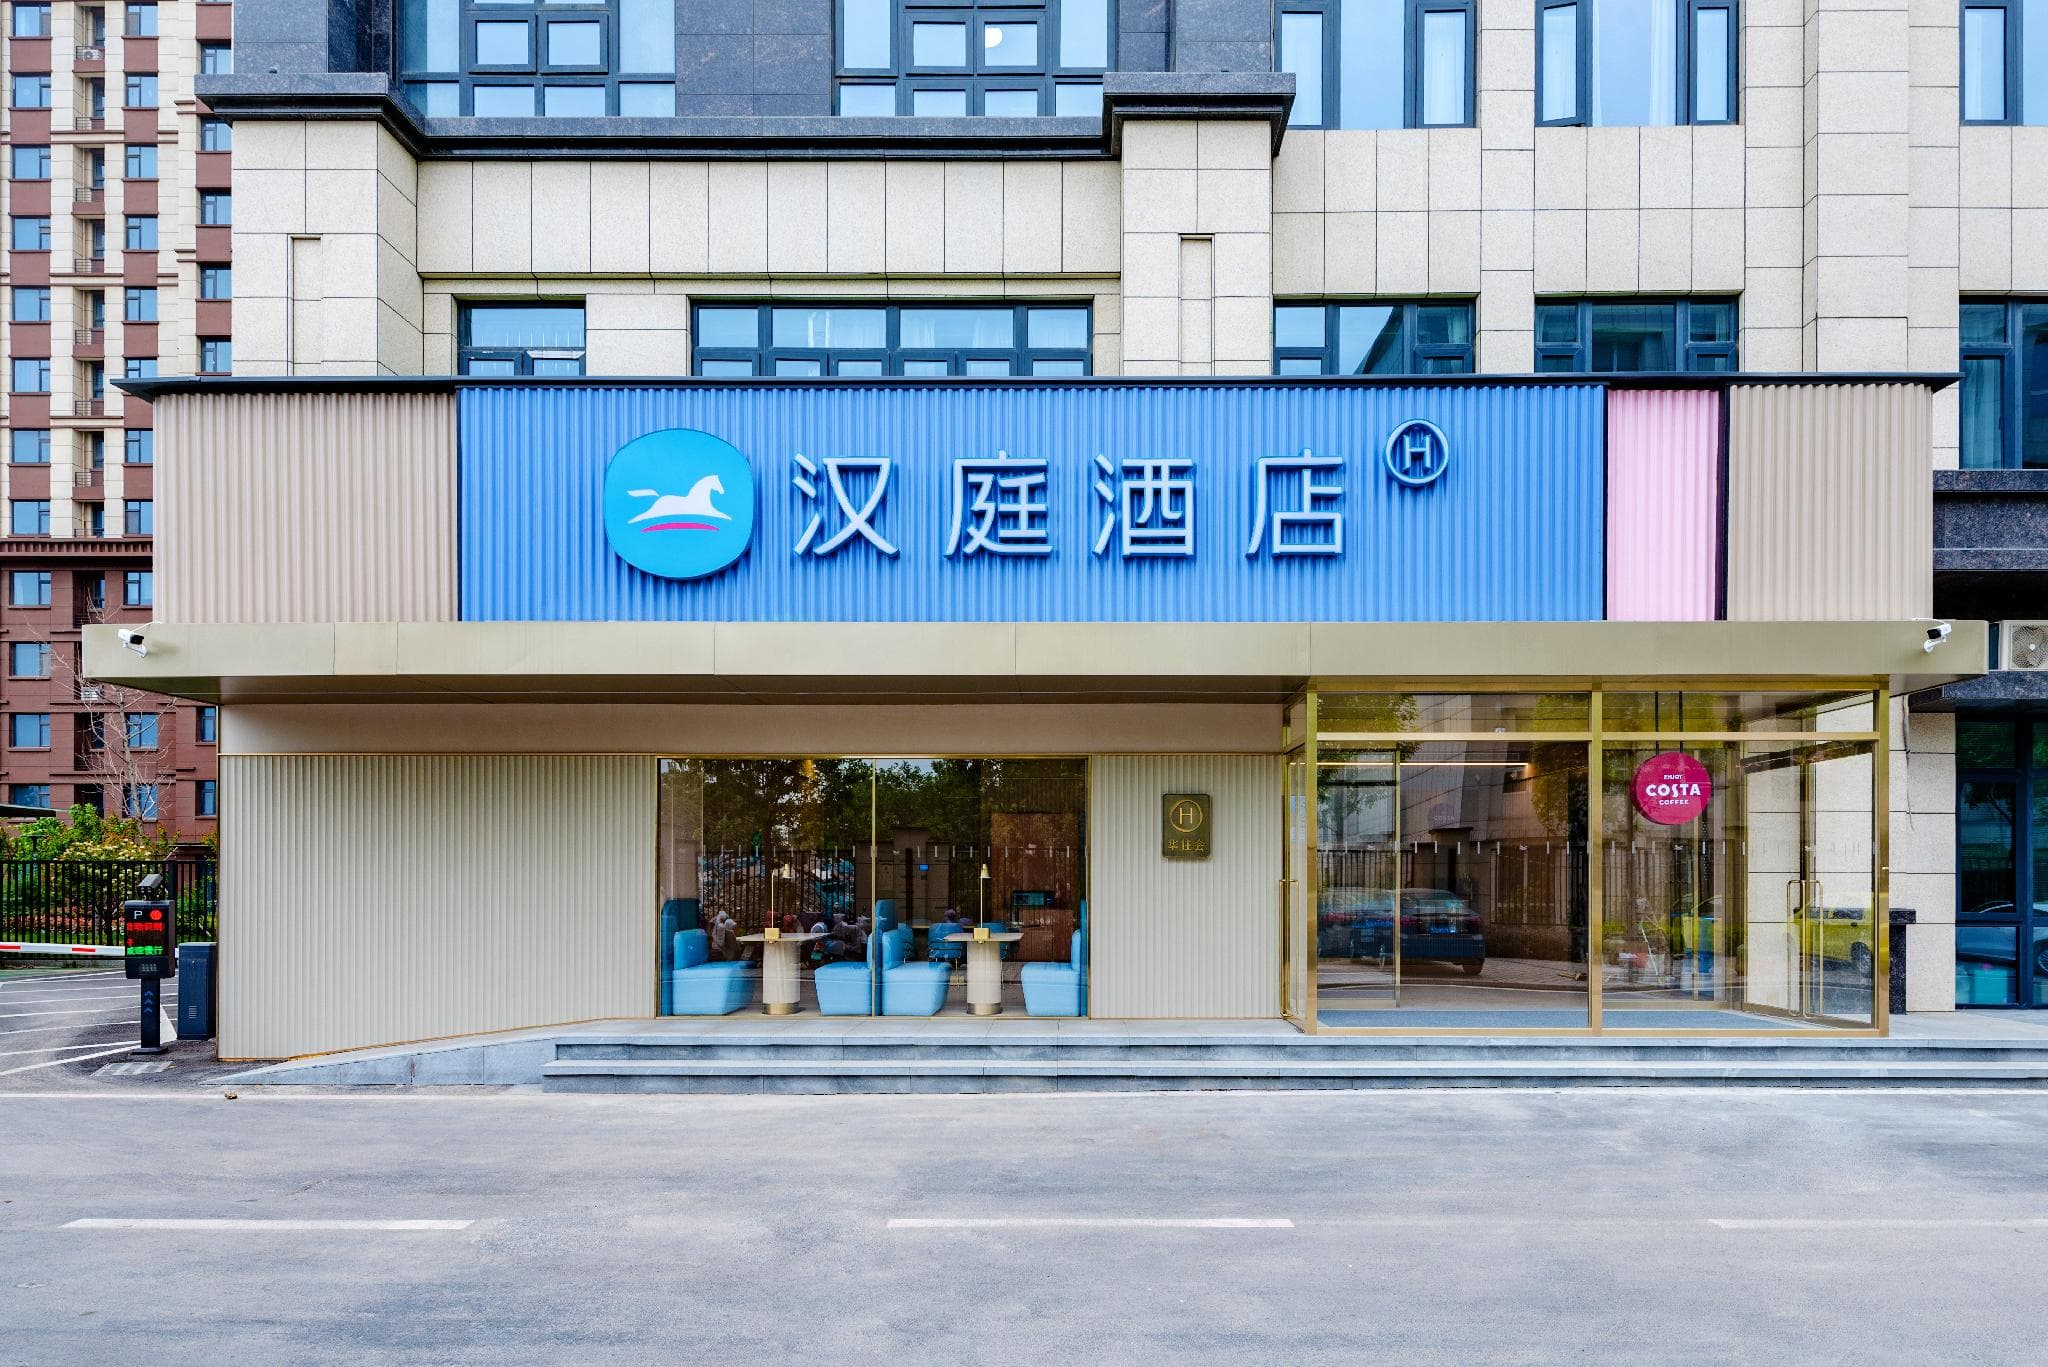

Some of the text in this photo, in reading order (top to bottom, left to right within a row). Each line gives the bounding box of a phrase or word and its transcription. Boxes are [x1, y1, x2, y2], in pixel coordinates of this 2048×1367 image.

[793, 449, 1346, 558] 汉庭酒店
[1645, 783, 1702, 798] COSTA
[134, 910, 143, 920] P
